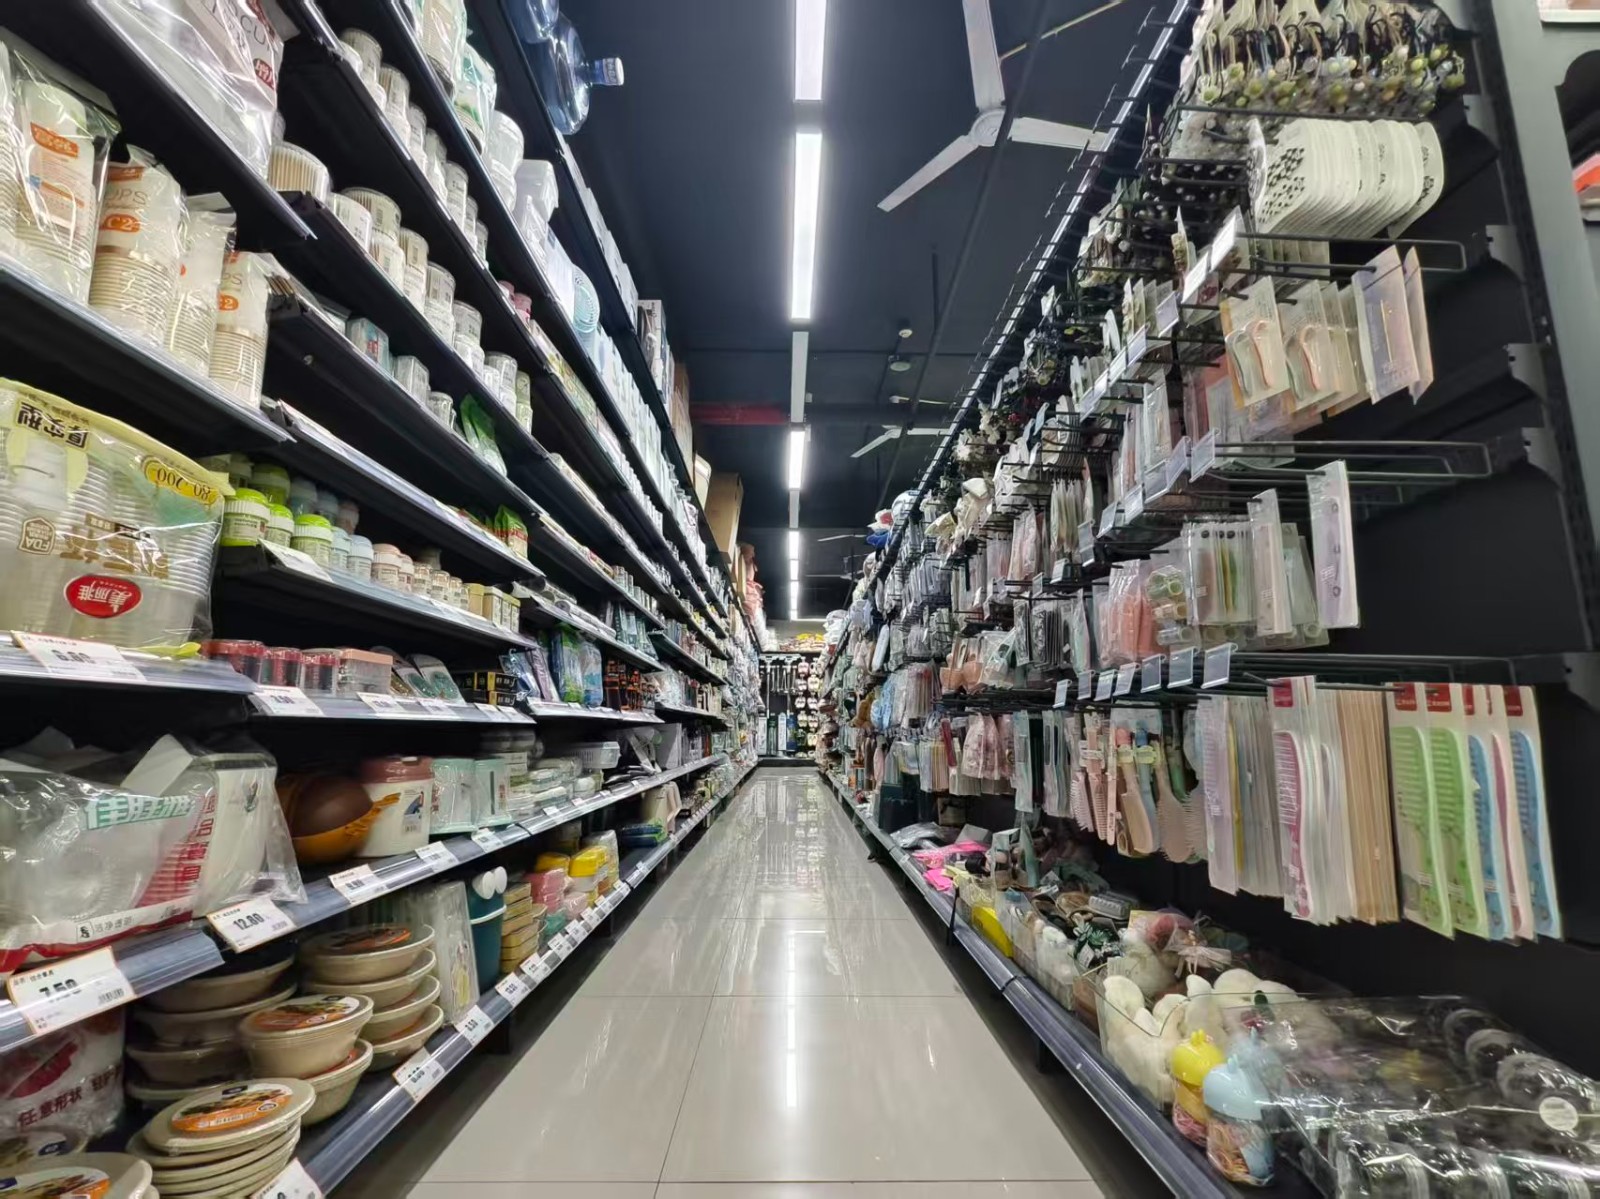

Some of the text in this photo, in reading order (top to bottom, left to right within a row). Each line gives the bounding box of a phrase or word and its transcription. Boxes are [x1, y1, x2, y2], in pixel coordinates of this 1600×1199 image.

[17, 402, 88, 449] 厚实型
[24, 536, 50, 551] FDA
[77, 582, 132, 613] 美丽雅
[39, 978, 78, 998] 750
[17, 1086, 83, 1126] 任意形状
